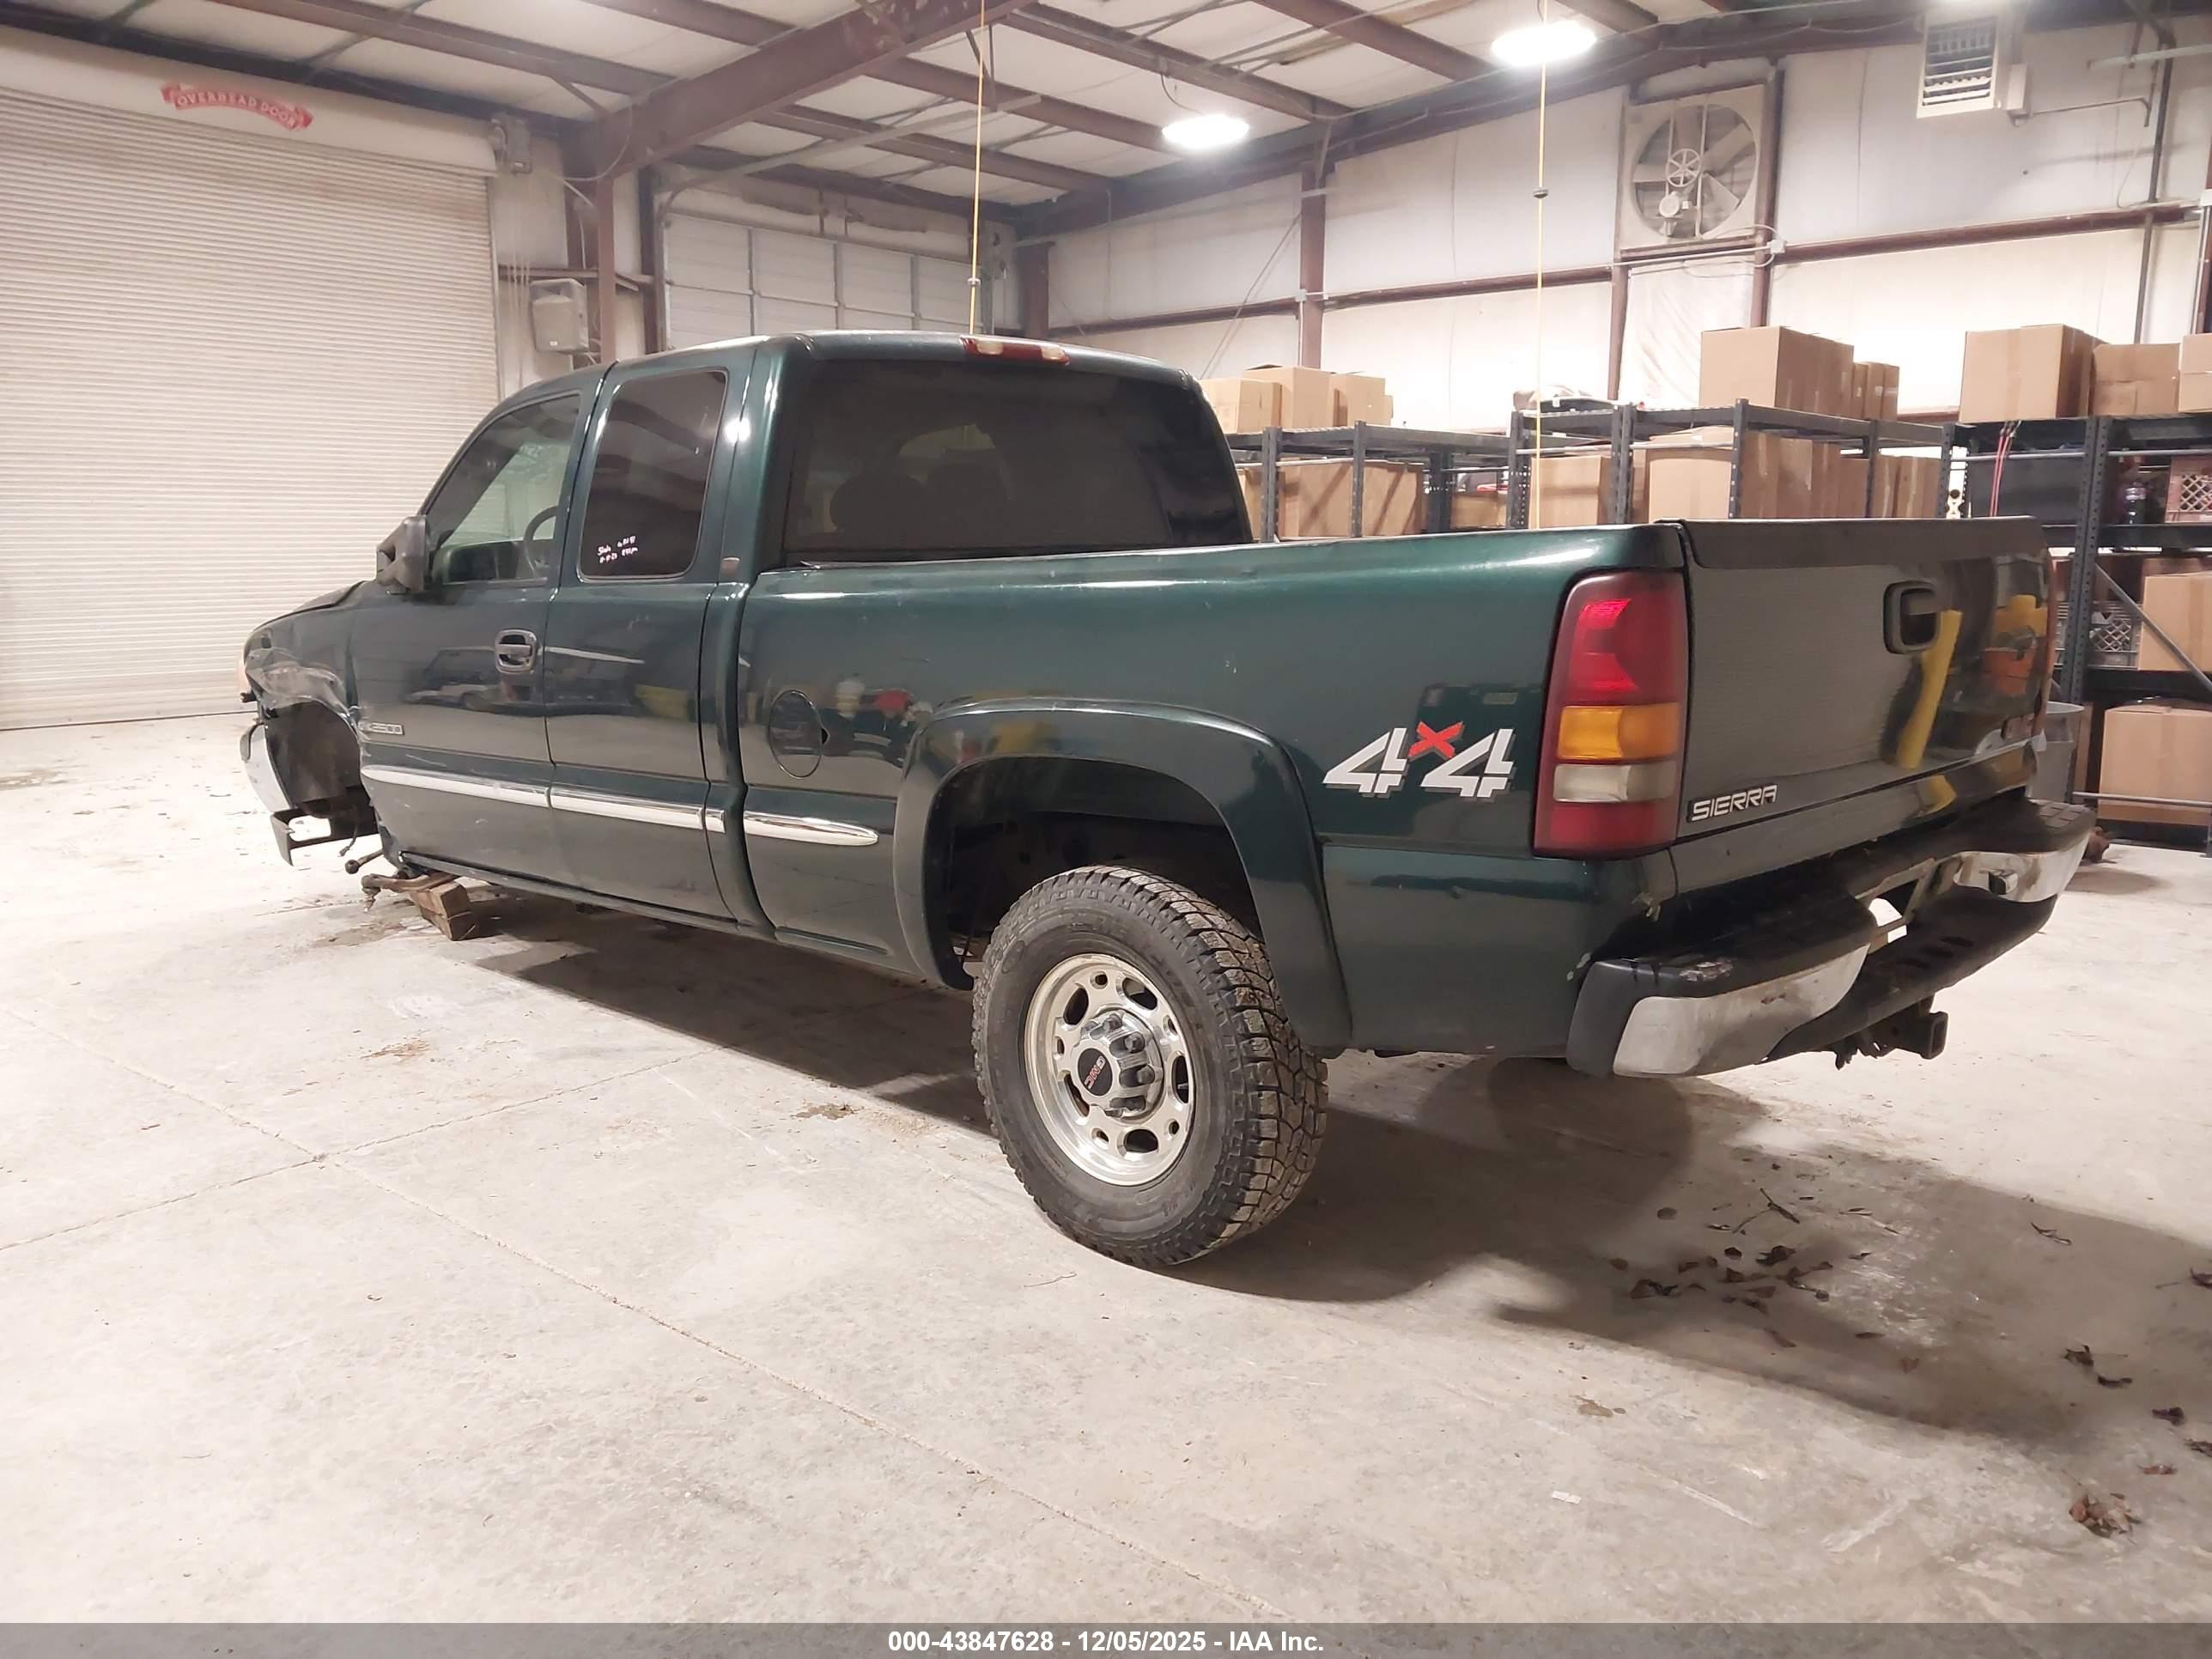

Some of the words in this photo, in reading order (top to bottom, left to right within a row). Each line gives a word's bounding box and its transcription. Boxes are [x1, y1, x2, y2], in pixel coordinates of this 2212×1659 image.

[177, 91, 257, 108] OVERHEAD
[260, 101, 296, 127] DOOR
[1690, 784, 1778, 822] SIERRA
[1085, 1055, 1107, 1090] GMC
